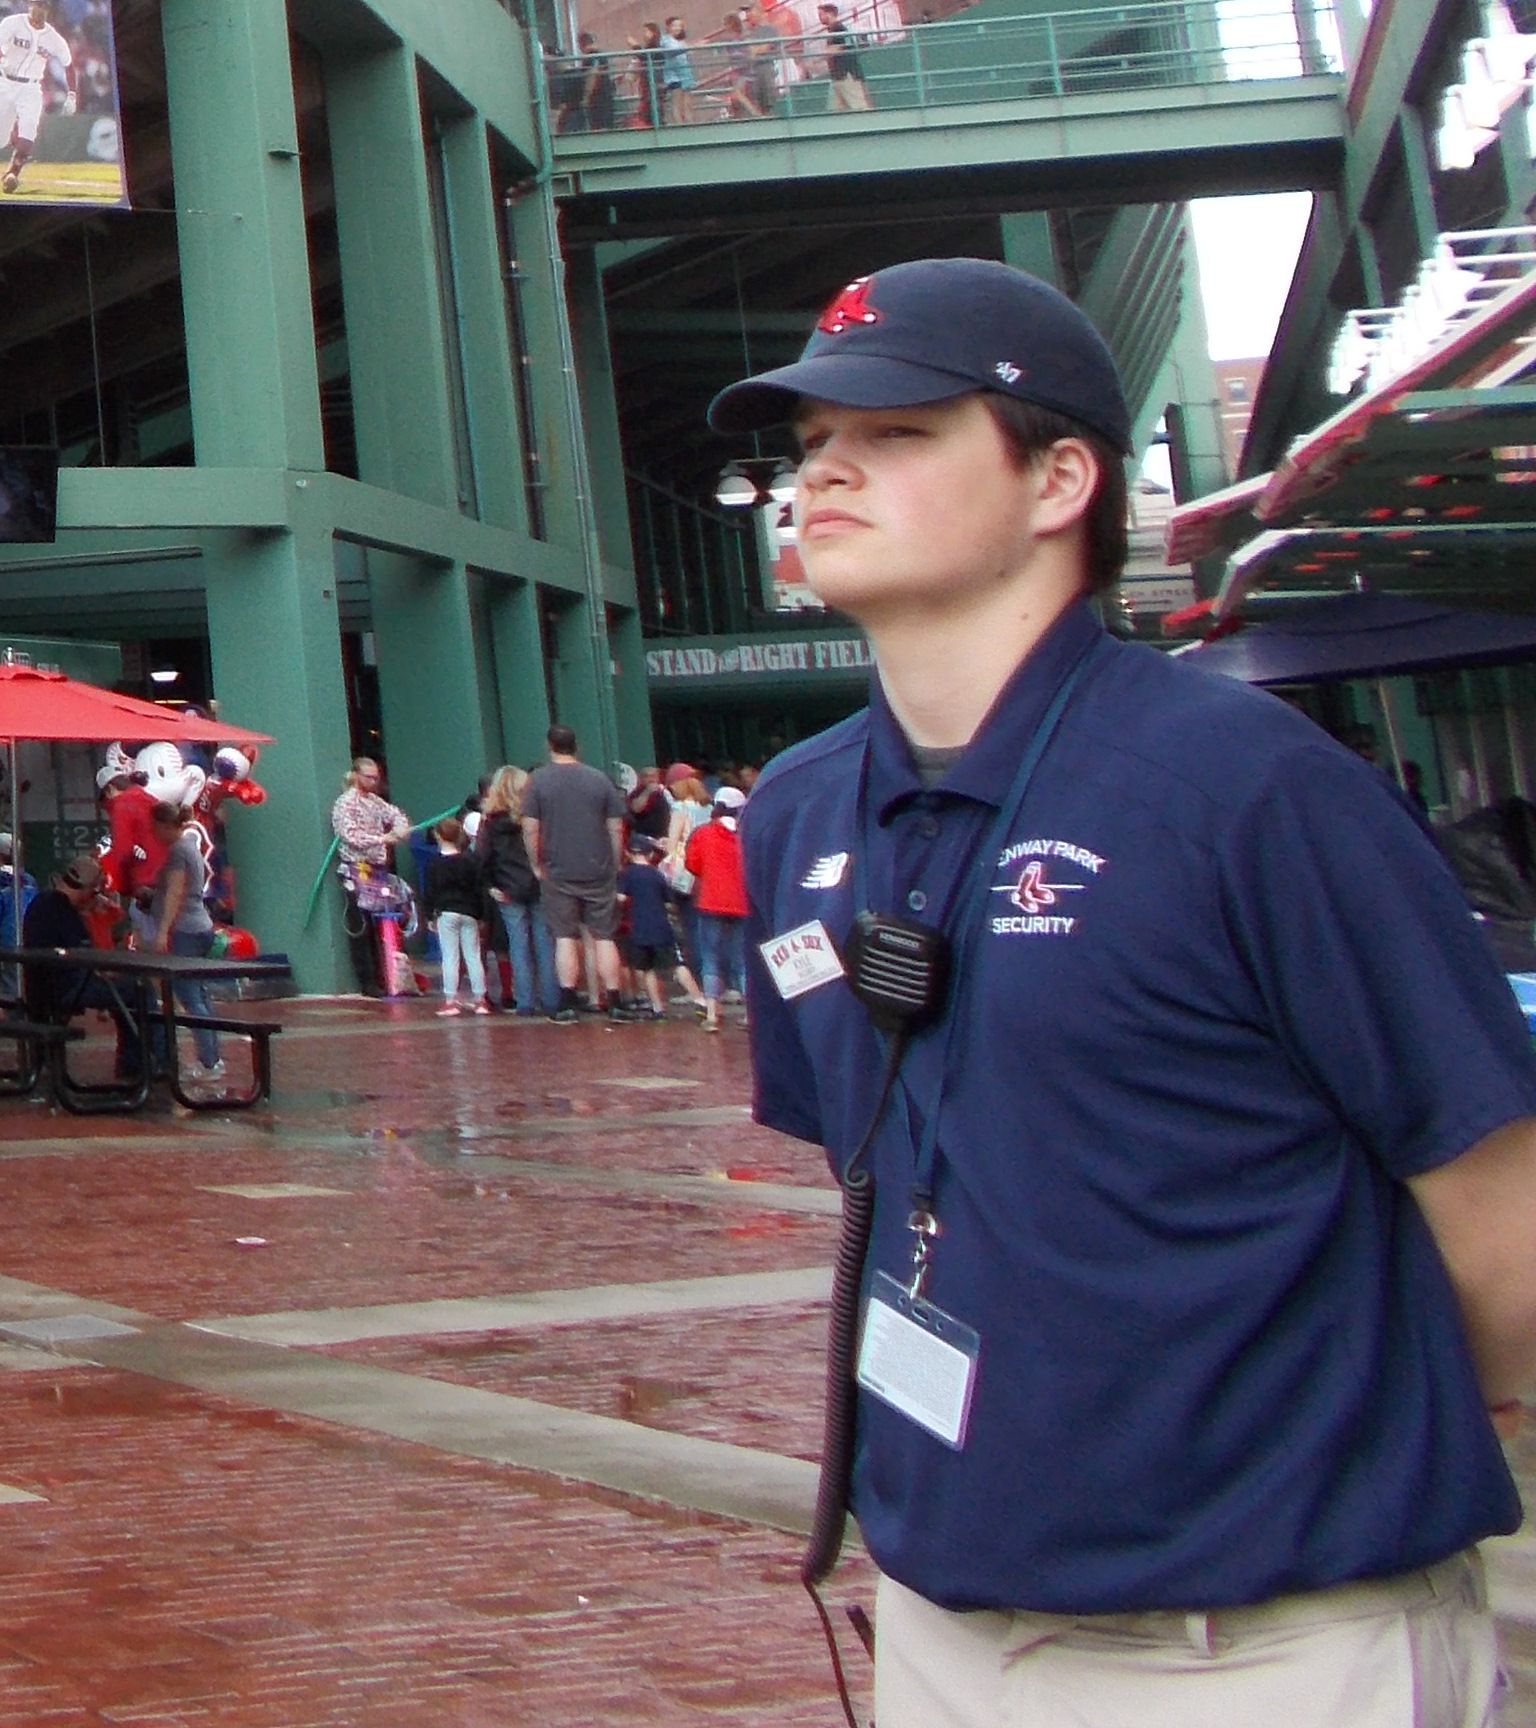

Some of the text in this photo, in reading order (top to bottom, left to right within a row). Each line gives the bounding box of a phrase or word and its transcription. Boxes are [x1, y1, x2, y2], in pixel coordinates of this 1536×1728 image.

[646, 647, 717, 677] STAND
[738, 642, 810, 672] RIGHT
[992, 915, 1075, 934] SECURITY
